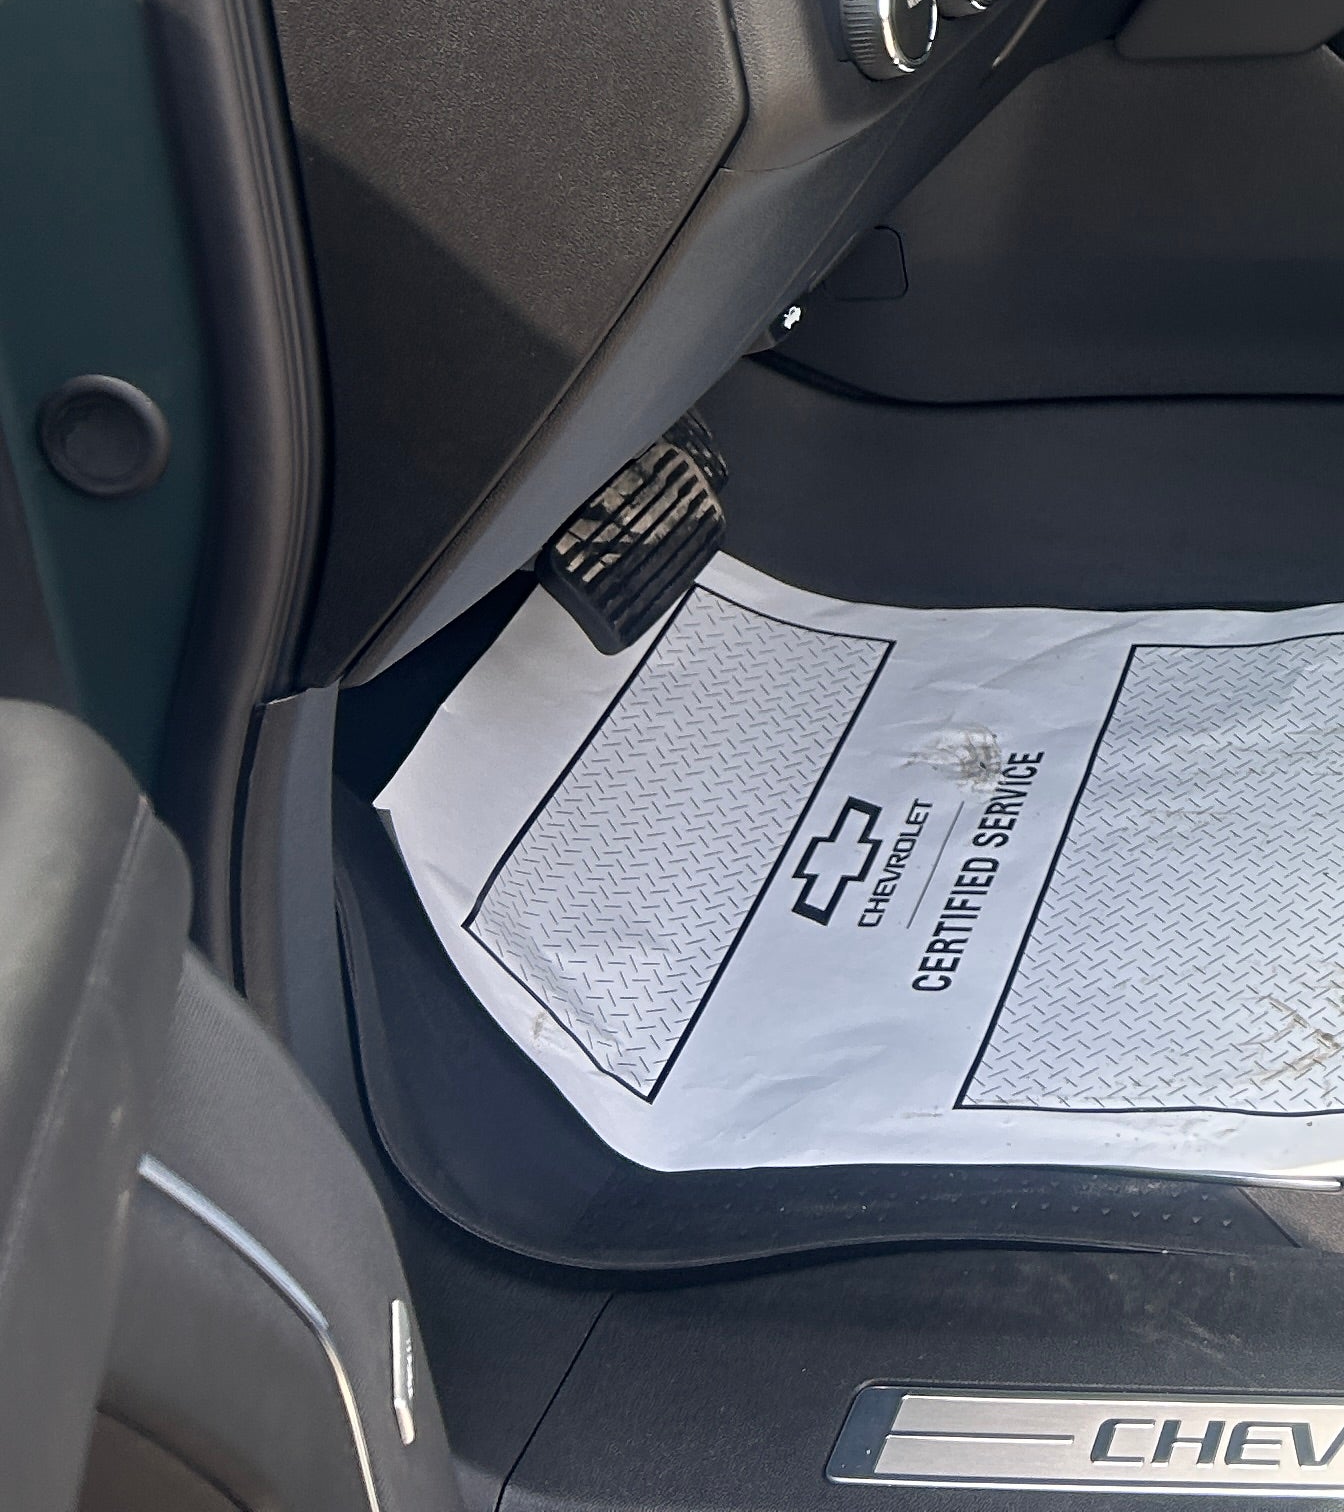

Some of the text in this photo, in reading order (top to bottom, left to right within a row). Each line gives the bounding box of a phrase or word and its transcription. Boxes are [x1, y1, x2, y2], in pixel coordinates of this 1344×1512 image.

[857, 798, 933, 927] CHEVROLET
[912, 751, 1045, 991] CERTIFIED SERVICE
